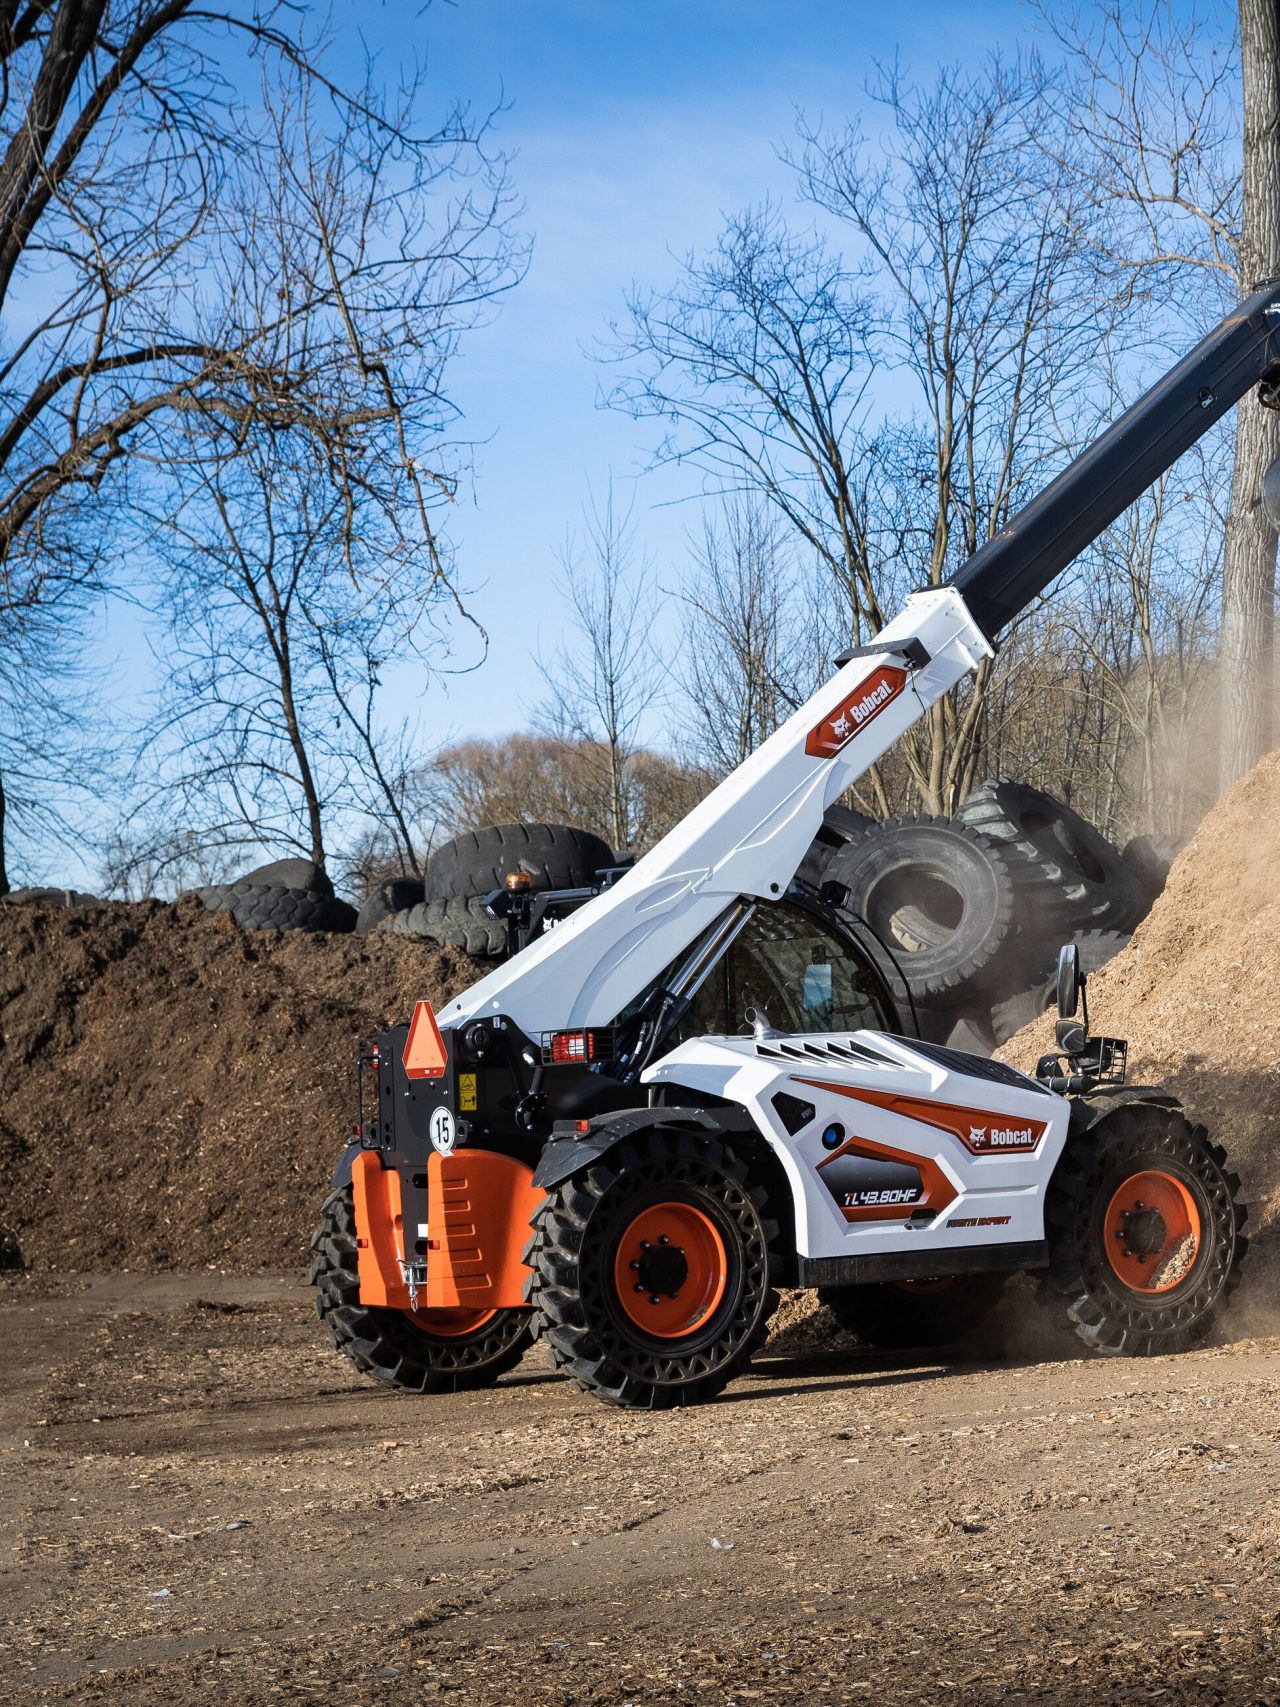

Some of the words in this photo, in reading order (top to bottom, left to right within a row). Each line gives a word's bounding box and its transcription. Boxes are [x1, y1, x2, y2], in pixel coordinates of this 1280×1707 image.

[849, 679, 893, 724] Bobcat
[436, 1117, 449, 1144] 15
[990, 1127, 1032, 1146] Bobcat
